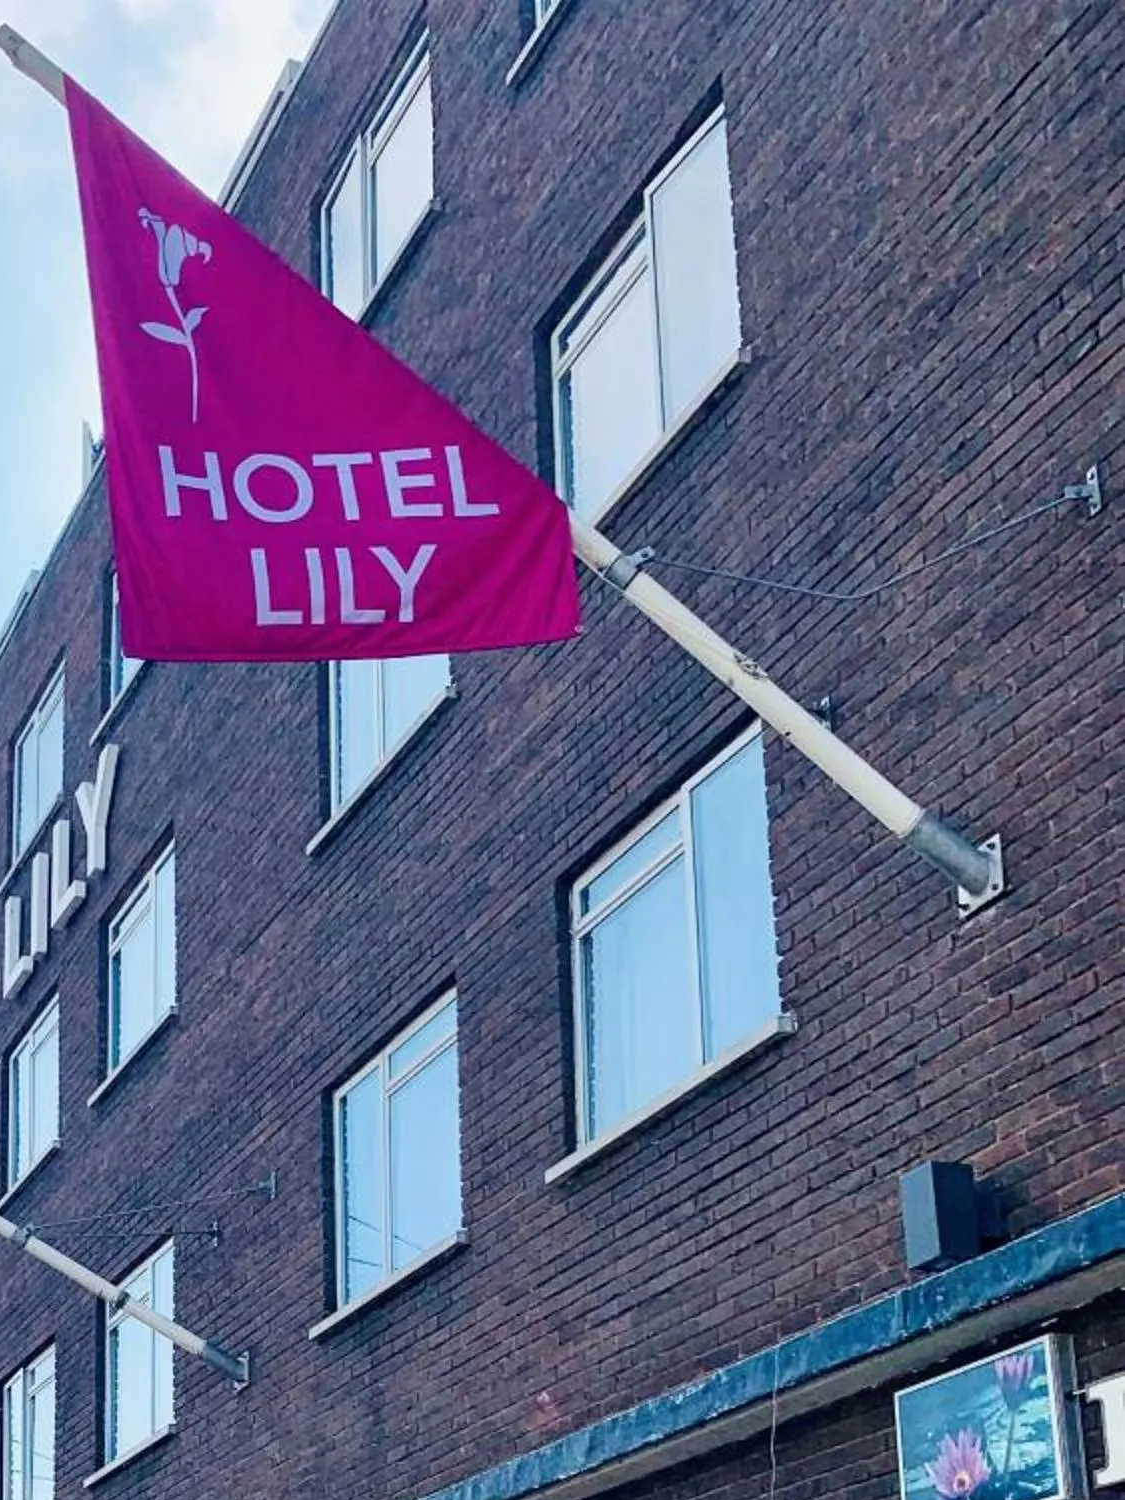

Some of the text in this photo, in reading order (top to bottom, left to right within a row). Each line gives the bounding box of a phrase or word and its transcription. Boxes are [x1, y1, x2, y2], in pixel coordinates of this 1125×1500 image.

[158, 445, 500, 523] HOTEL
[250, 544, 437, 626] LILY
[3, 743, 120, 999] LILY
